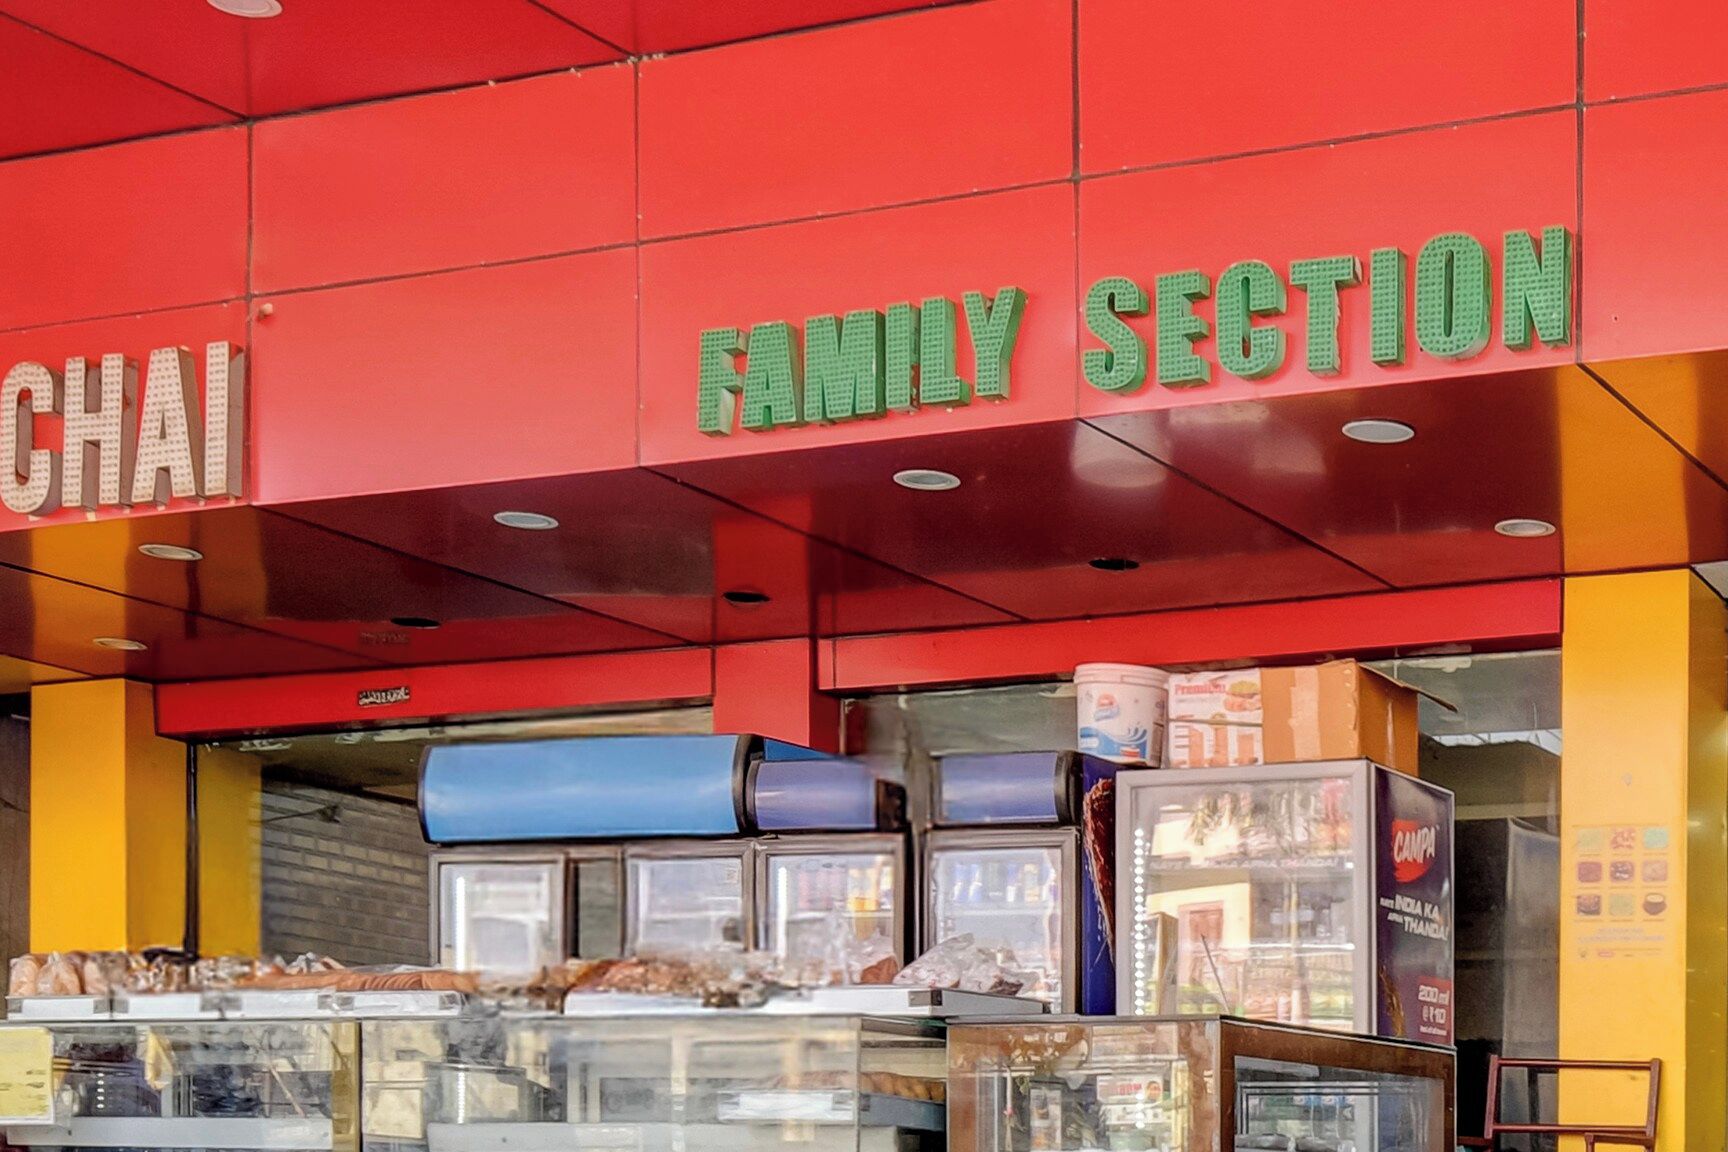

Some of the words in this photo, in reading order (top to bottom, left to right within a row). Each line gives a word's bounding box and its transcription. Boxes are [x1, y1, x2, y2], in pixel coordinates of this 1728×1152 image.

[697, 286, 1029, 436] FAMILY
[1083, 224, 1573, 395] SECTION
[0, 341, 245, 517] CHAI
[1394, 825, 1436, 864] CAMPA
[1395, 894, 1423, 916] INDIA
[1424, 902, 1440, 921] KA
[1404, 916, 1449, 941] THANDA!
